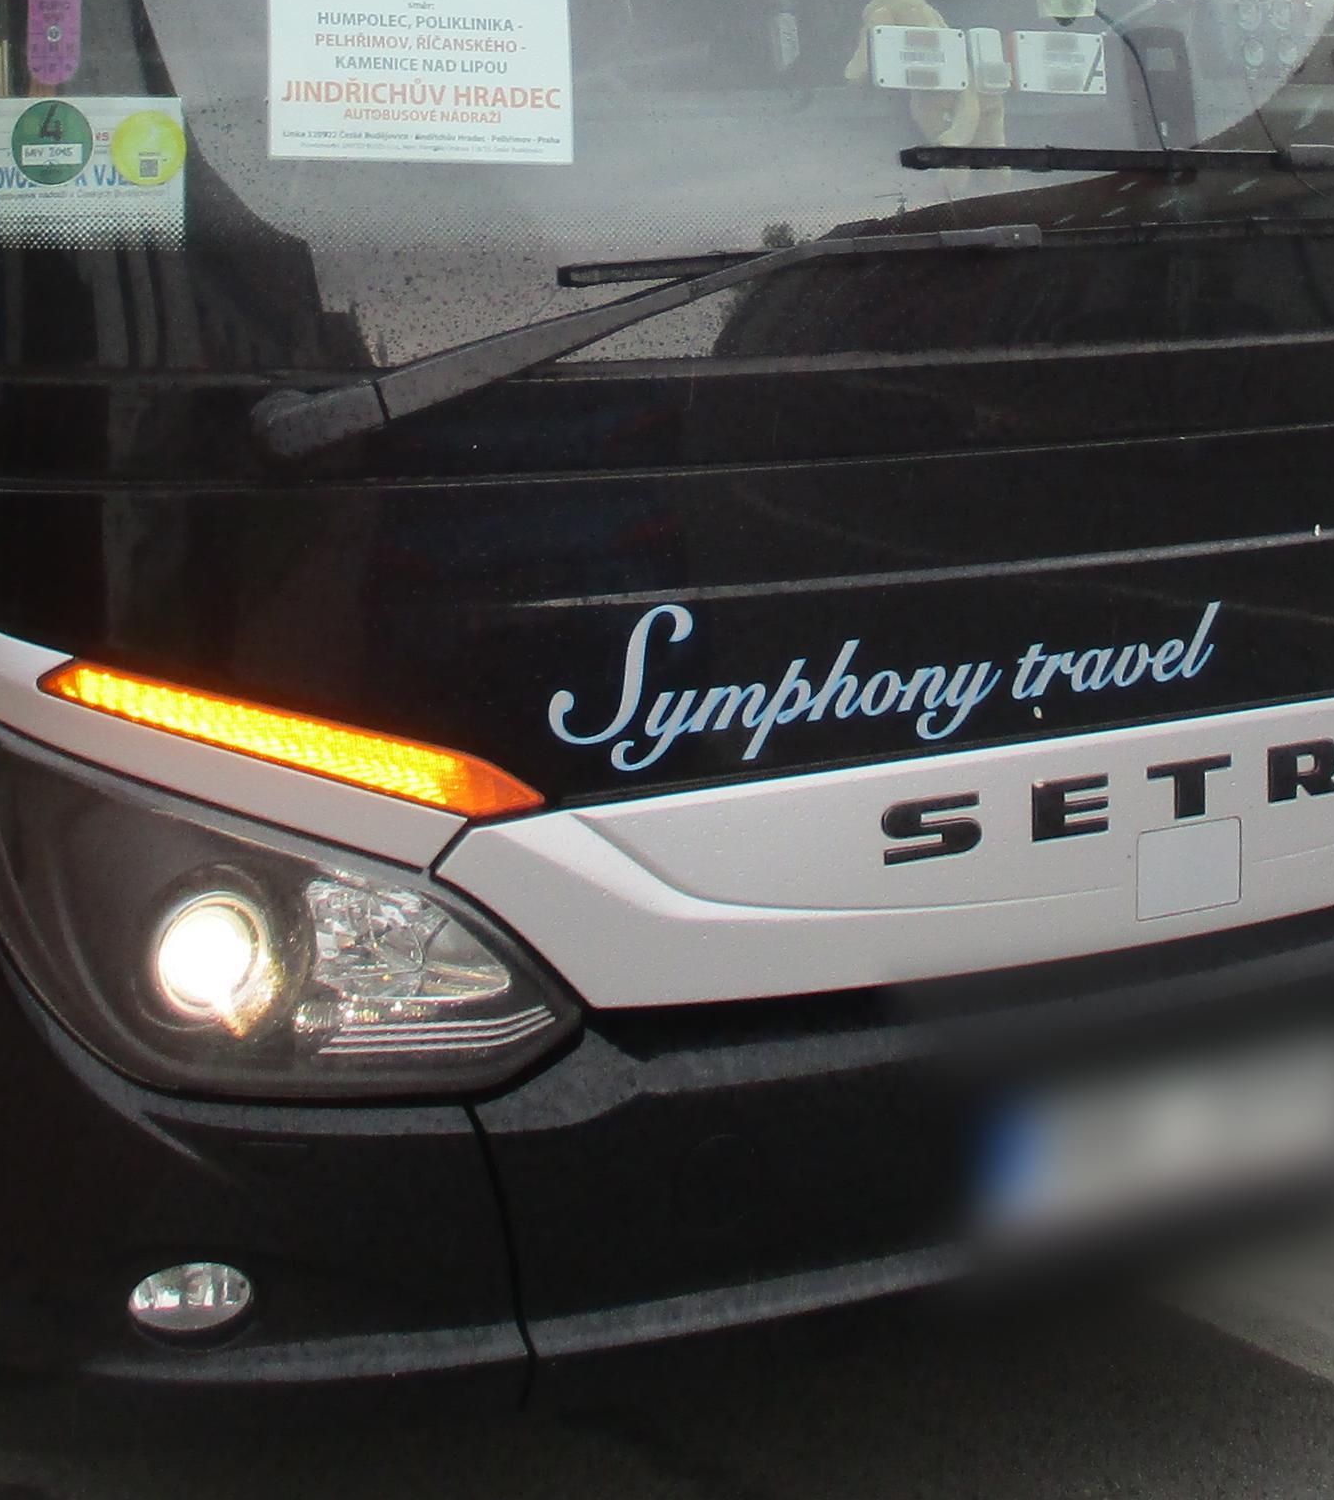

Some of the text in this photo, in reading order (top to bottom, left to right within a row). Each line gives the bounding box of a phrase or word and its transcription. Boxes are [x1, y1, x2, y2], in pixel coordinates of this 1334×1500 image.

[317, 11, 412, 30] HUMPOLEC,
[416, 15, 514, 32] POLIKLINIKA
[315, 32, 413, 52] PELHŘIMOV,
[416, 34, 517, 54] ŘÍČANSKÉHO
[335, 56, 508, 75] KAMENICE NAD LIPOU
[281, 77, 561, 109] JINDŘICHŮV HRADEC
[343, 107, 502, 124] AUTOBUSOVÉ NÁDRAŽÍ
[550, 600, 1222, 773] Symphony travel
